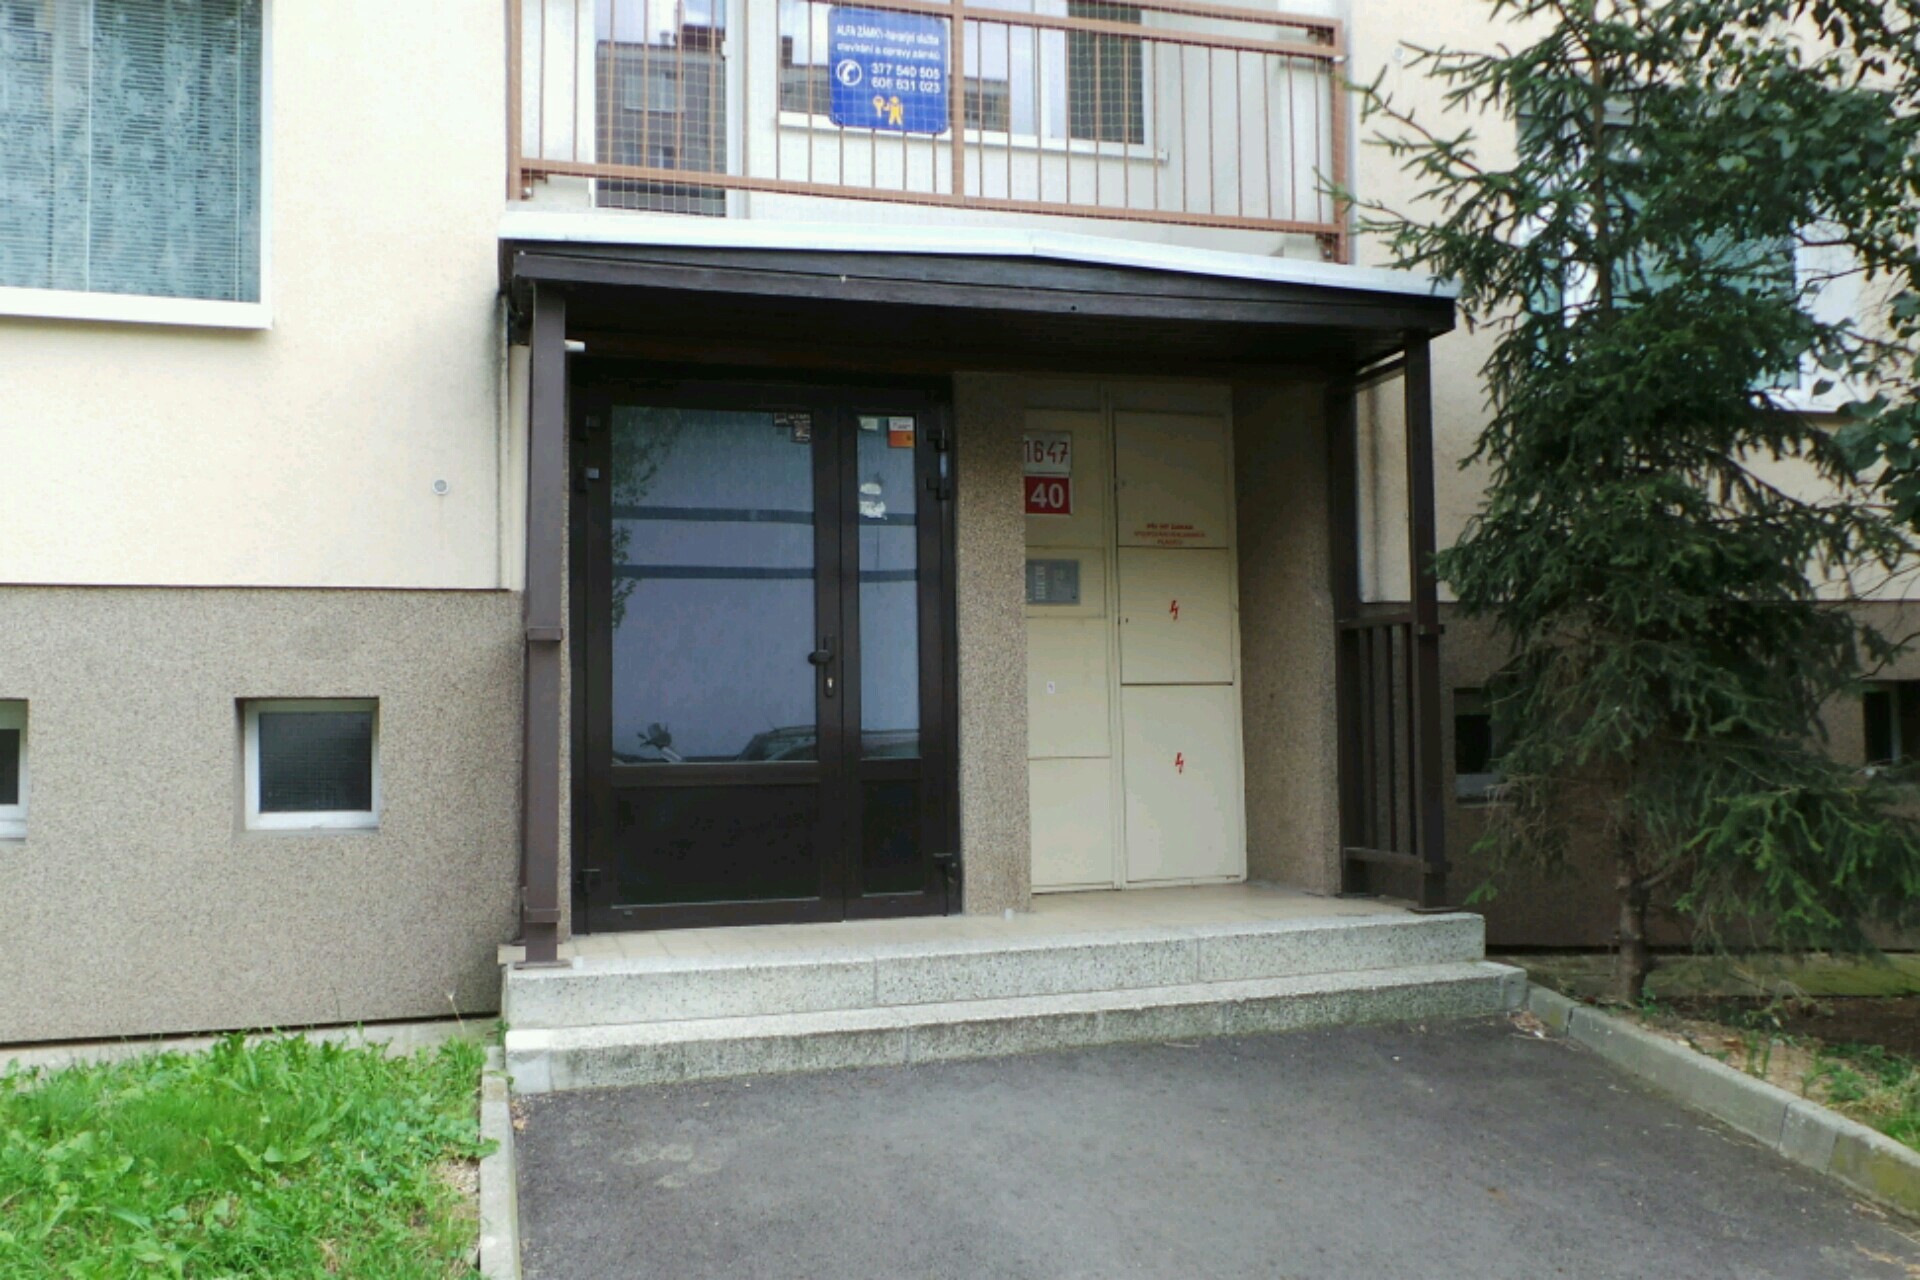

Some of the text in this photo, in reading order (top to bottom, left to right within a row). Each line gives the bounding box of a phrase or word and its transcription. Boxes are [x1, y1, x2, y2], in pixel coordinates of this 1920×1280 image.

[871, 62, 893, 75] 377
[919, 66, 941, 80] 505
[919, 80, 941, 94] 023
[1023, 440, 1068, 464] 1647
[1030, 483, 1065, 509] 40
